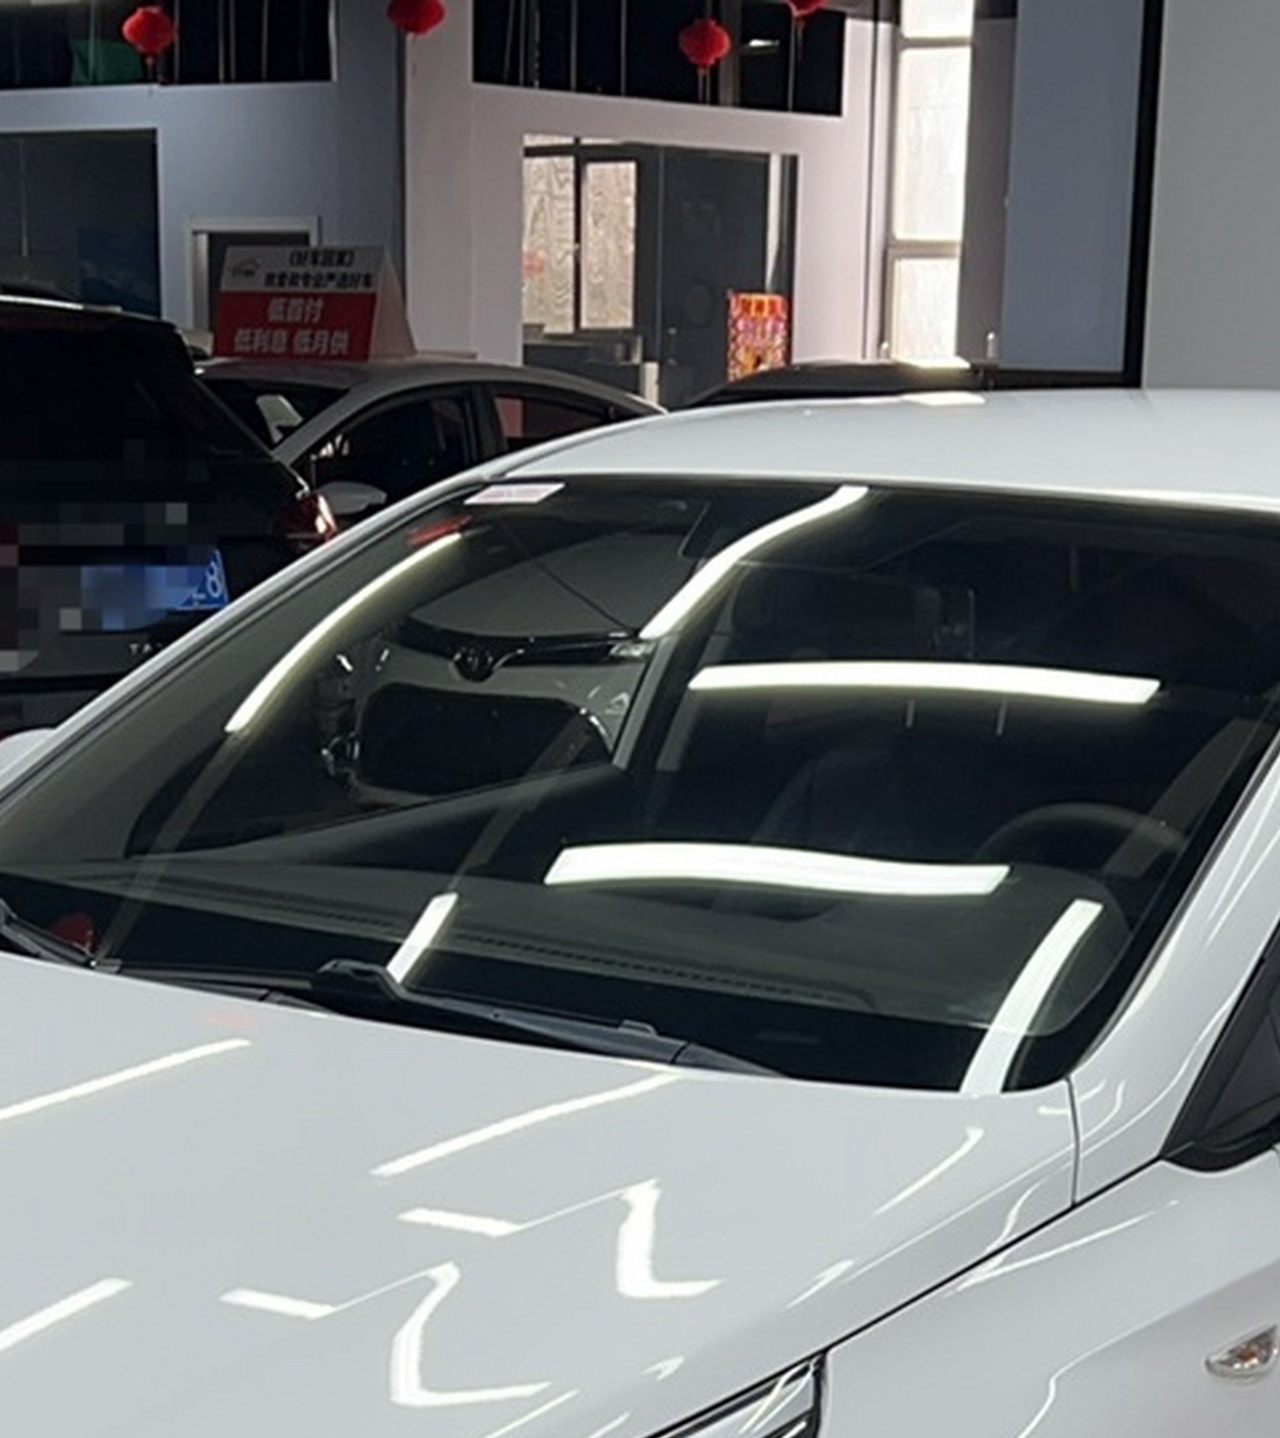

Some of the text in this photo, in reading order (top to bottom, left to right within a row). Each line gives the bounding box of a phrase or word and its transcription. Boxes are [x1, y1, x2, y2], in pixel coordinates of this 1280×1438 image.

[269, 297, 323, 324] 低首付
[234, 328, 349, 356] 低利息 低月供
